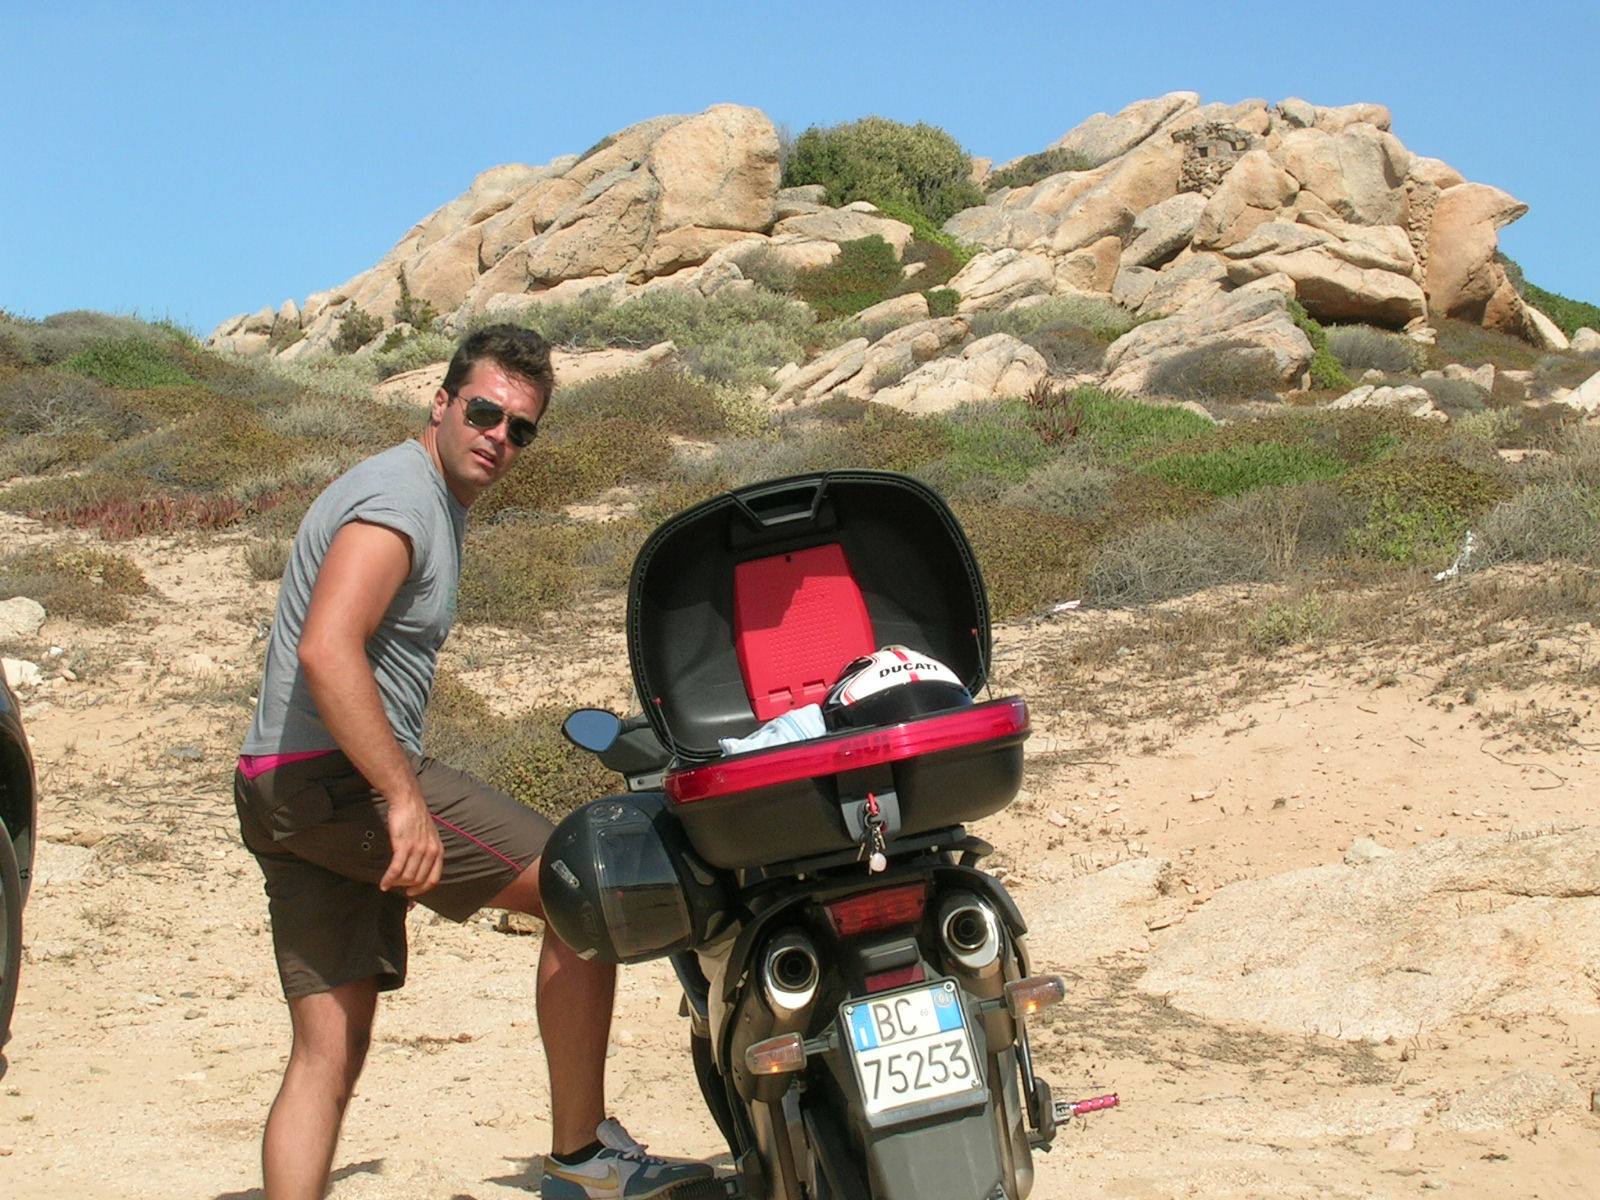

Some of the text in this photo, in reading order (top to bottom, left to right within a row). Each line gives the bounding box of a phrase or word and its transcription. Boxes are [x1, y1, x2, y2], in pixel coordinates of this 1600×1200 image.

[879, 662, 938, 679] DUCATI
[859, 1026, 869, 1047] I
[872, 998, 918, 1042] BC
[864, 1039, 971, 1100] 75253
